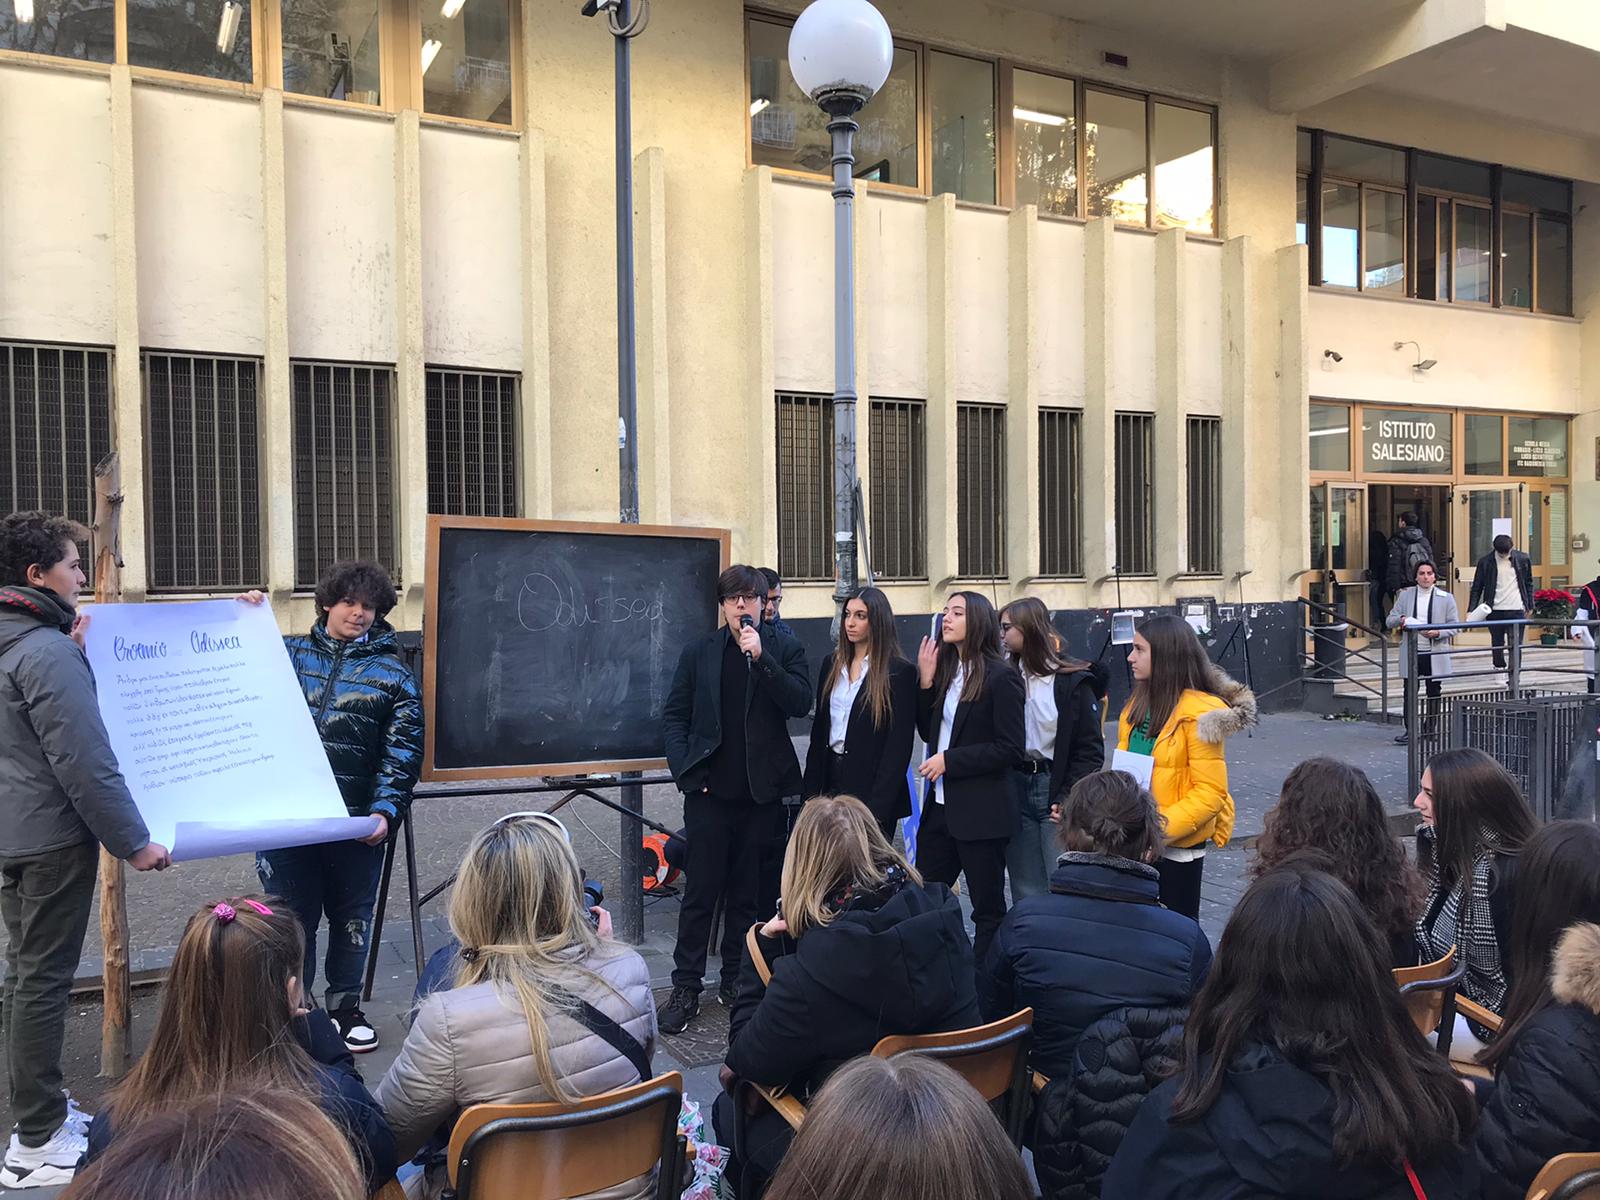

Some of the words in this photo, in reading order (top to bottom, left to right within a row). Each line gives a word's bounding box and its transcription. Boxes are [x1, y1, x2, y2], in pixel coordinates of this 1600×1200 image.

[1379, 420, 1436, 440] ISTITUTO
[1371, 442, 1445, 462] SALESIANO
[190, 630, 242, 654] Odissea
